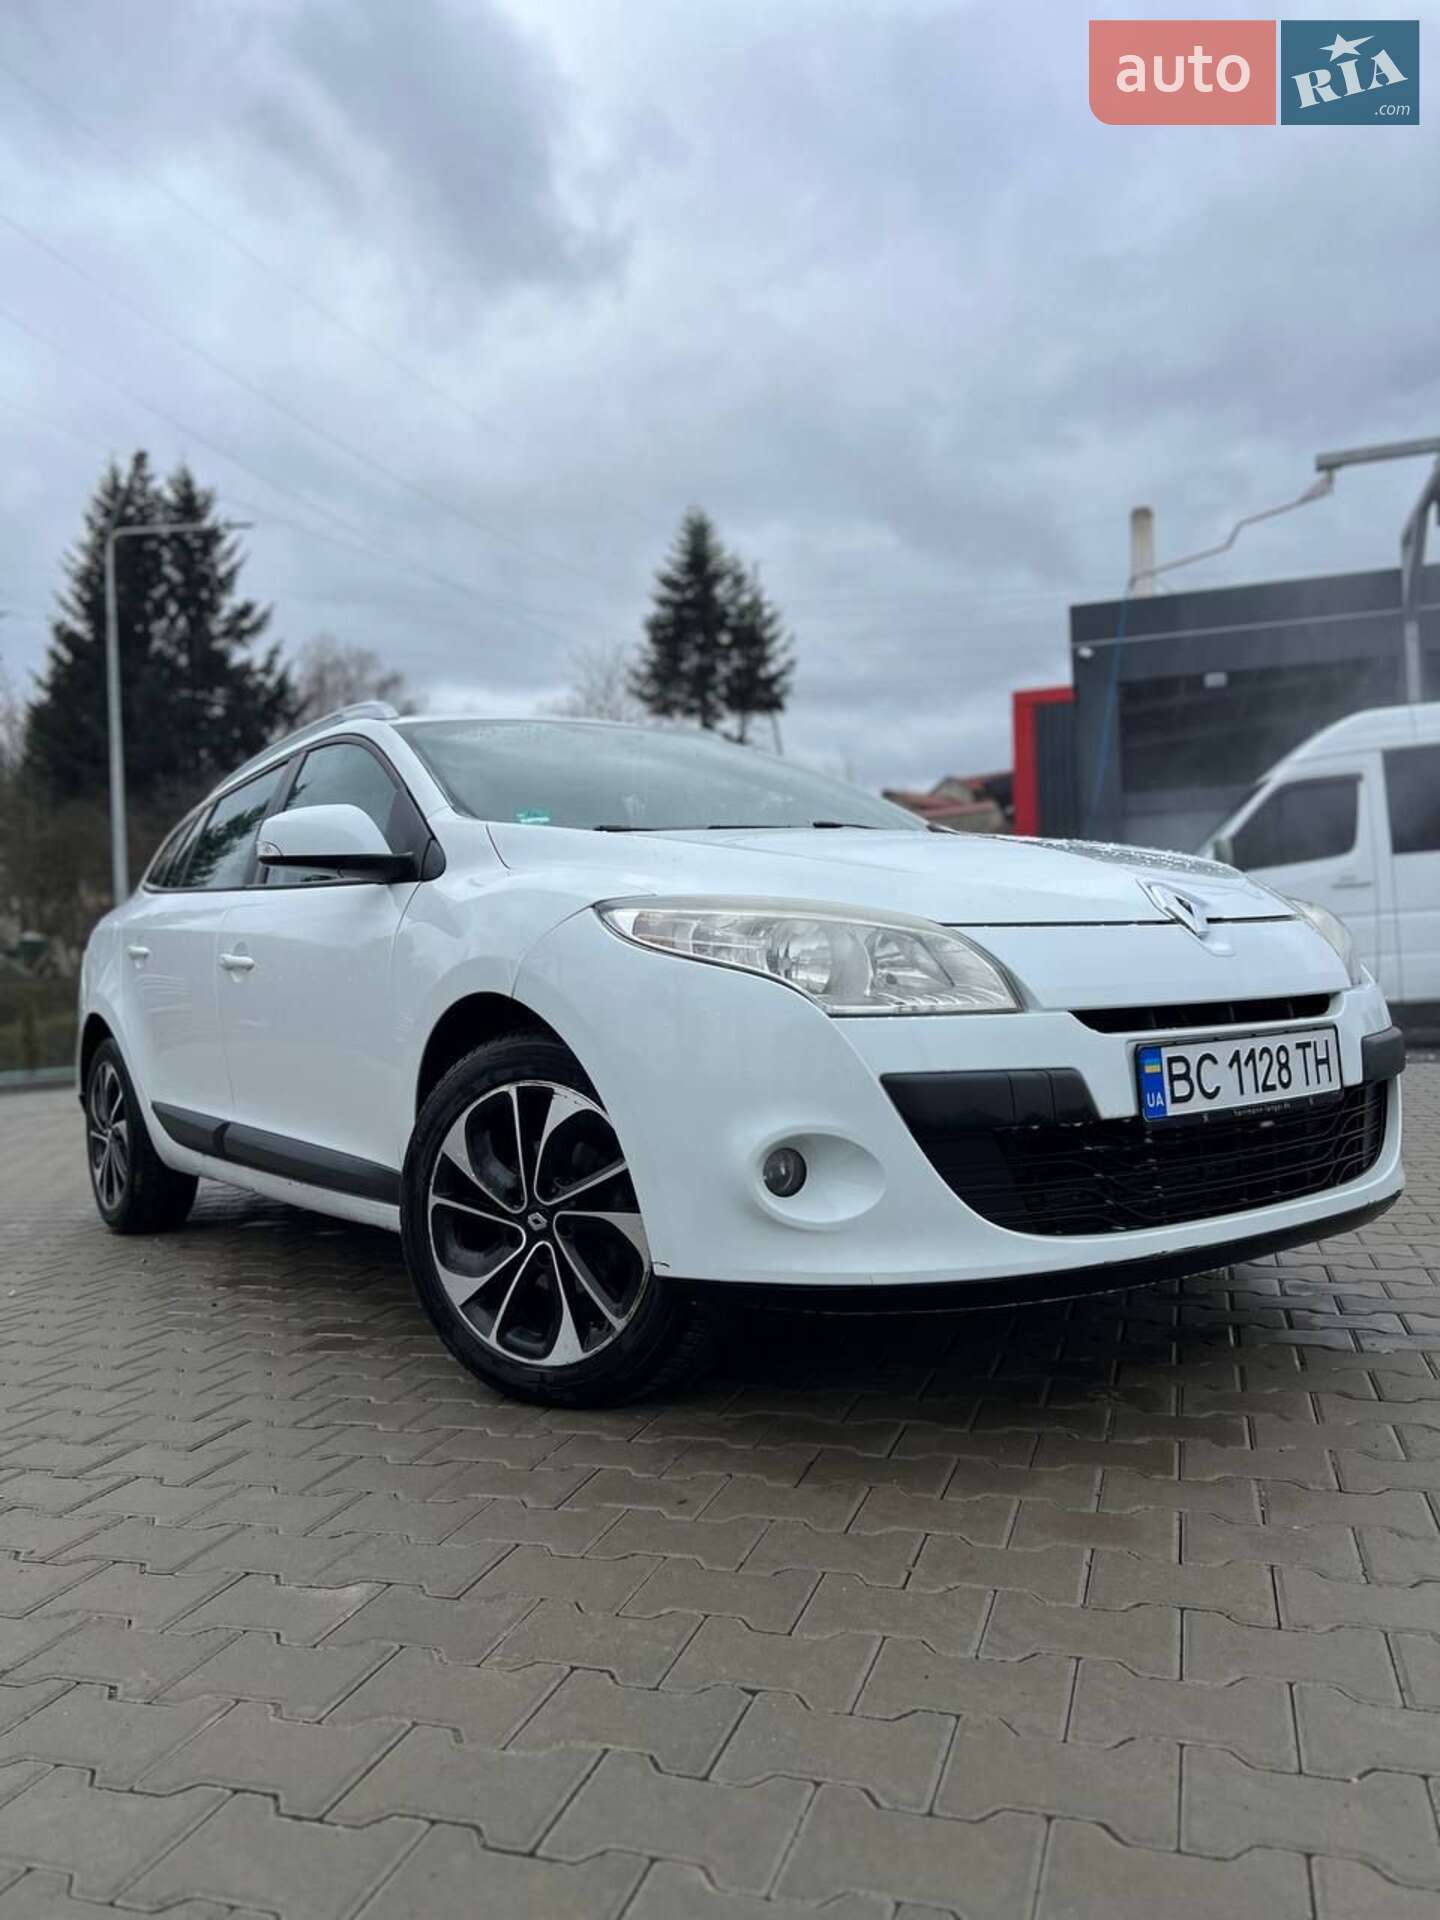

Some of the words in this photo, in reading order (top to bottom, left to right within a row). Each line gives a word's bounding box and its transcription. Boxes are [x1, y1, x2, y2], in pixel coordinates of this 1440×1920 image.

[1166, 1053, 1221, 1104] BC
[1228, 1045, 1293, 1096] 1128
[1295, 1039, 1333, 1086] TH
[1146, 1092, 1165, 1108] UA
